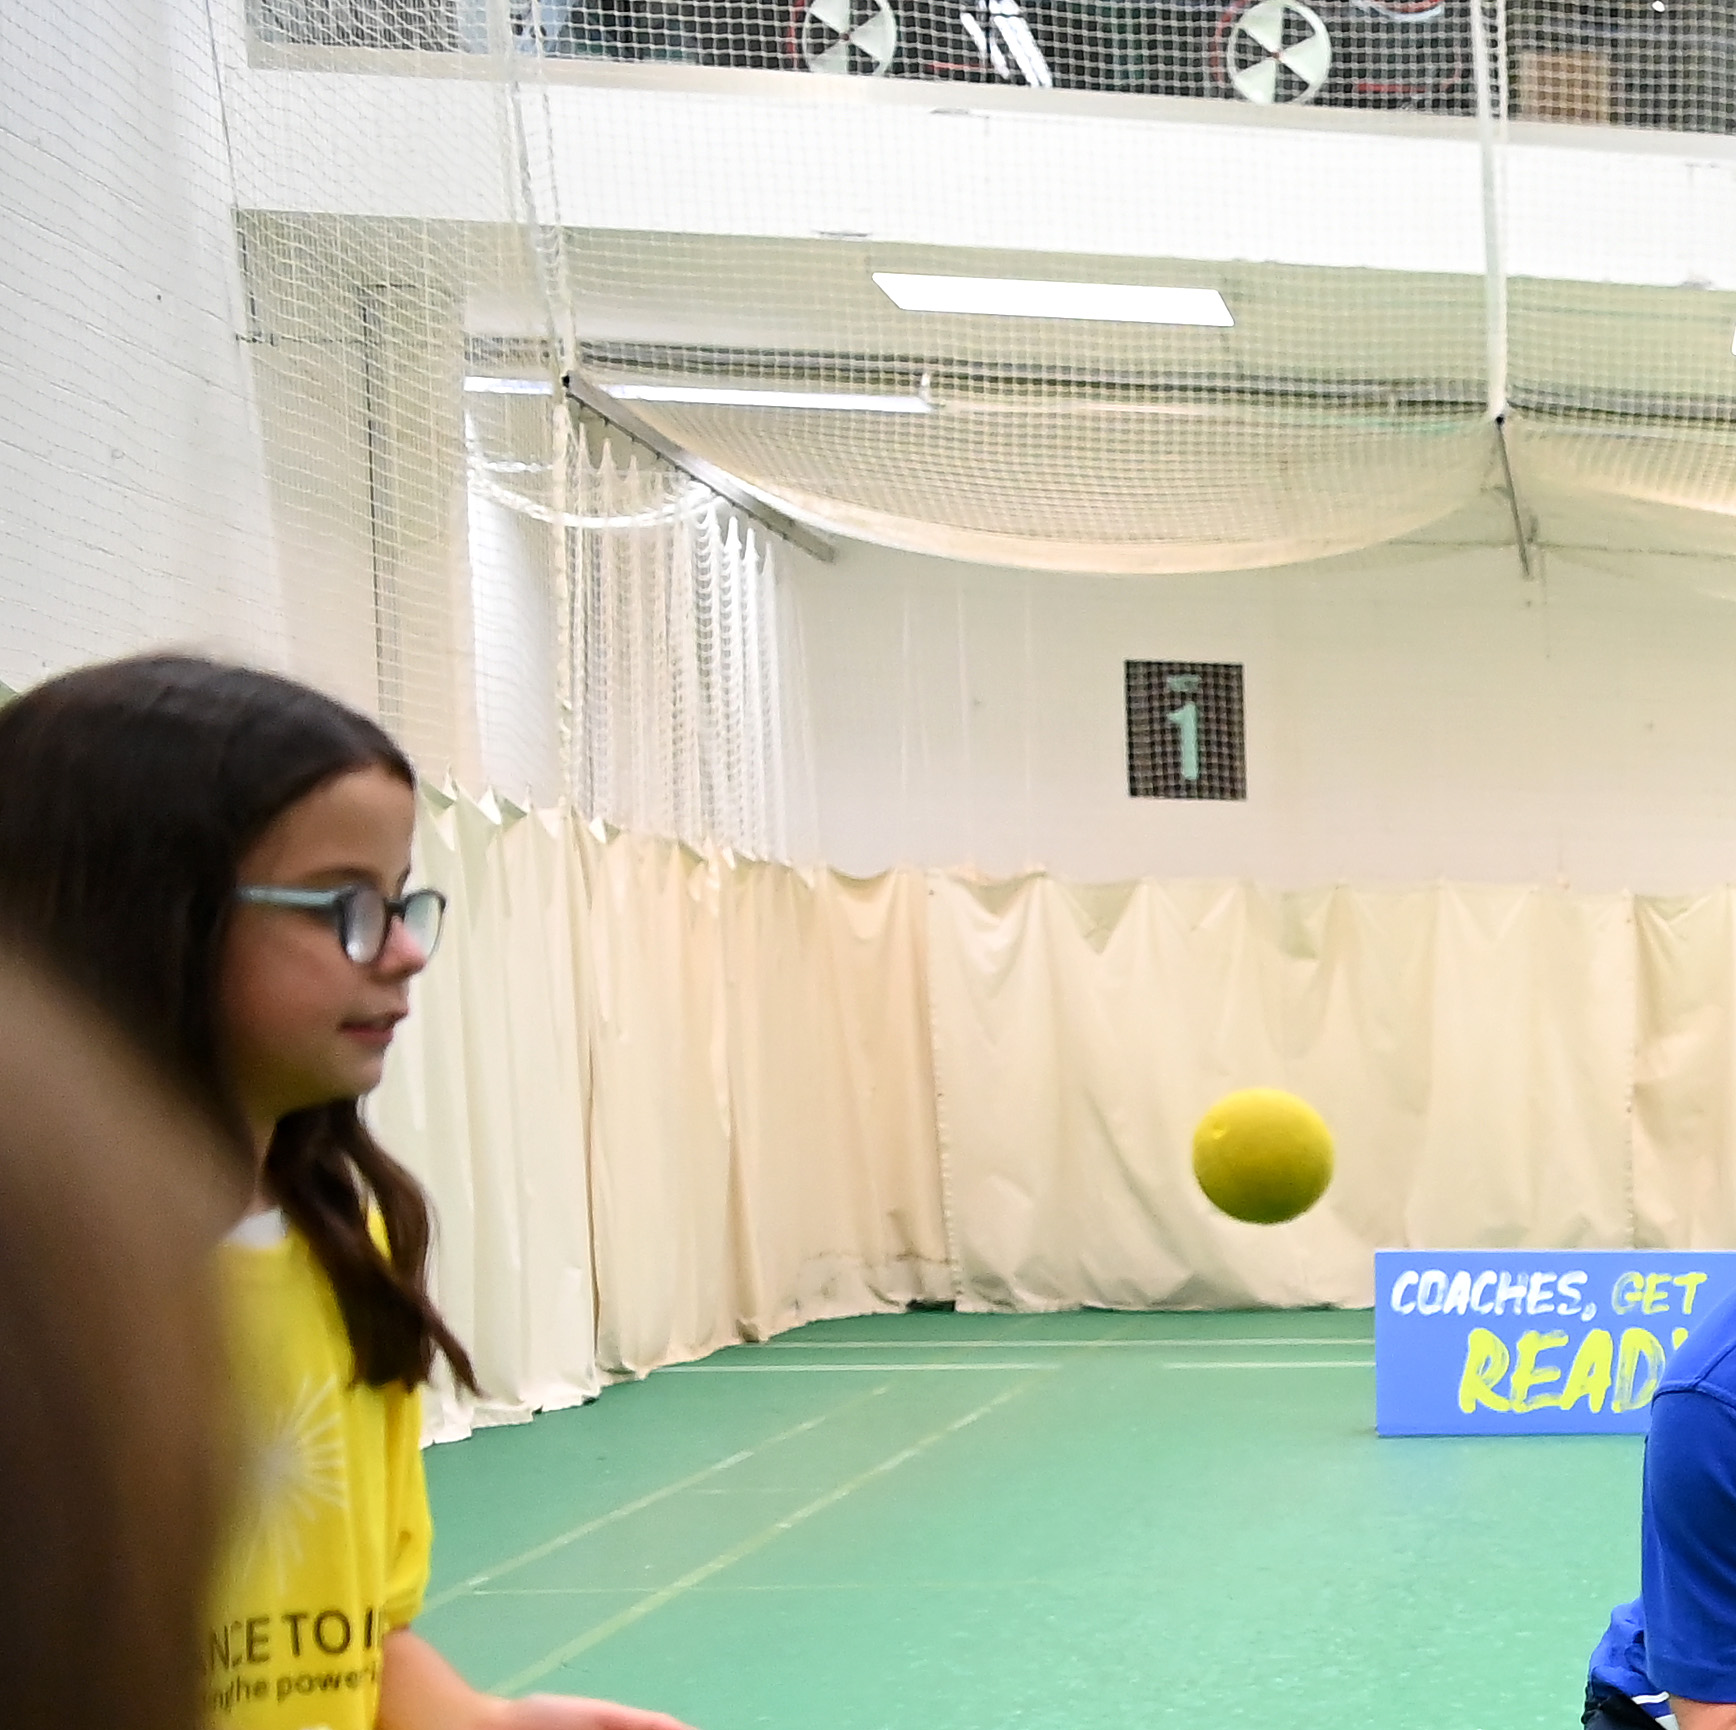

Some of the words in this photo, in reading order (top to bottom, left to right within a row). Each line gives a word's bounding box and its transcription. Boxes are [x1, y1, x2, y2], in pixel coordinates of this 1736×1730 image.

[1166, 700, 1198, 781] 1
[1391, 1269, 1597, 1322] COACHES,
[1612, 1272, 1708, 1316] GET
[1459, 1328, 1689, 1413] READ
[210, 1614, 270, 1670] NCE
[281, 1610, 351, 1658] TO
